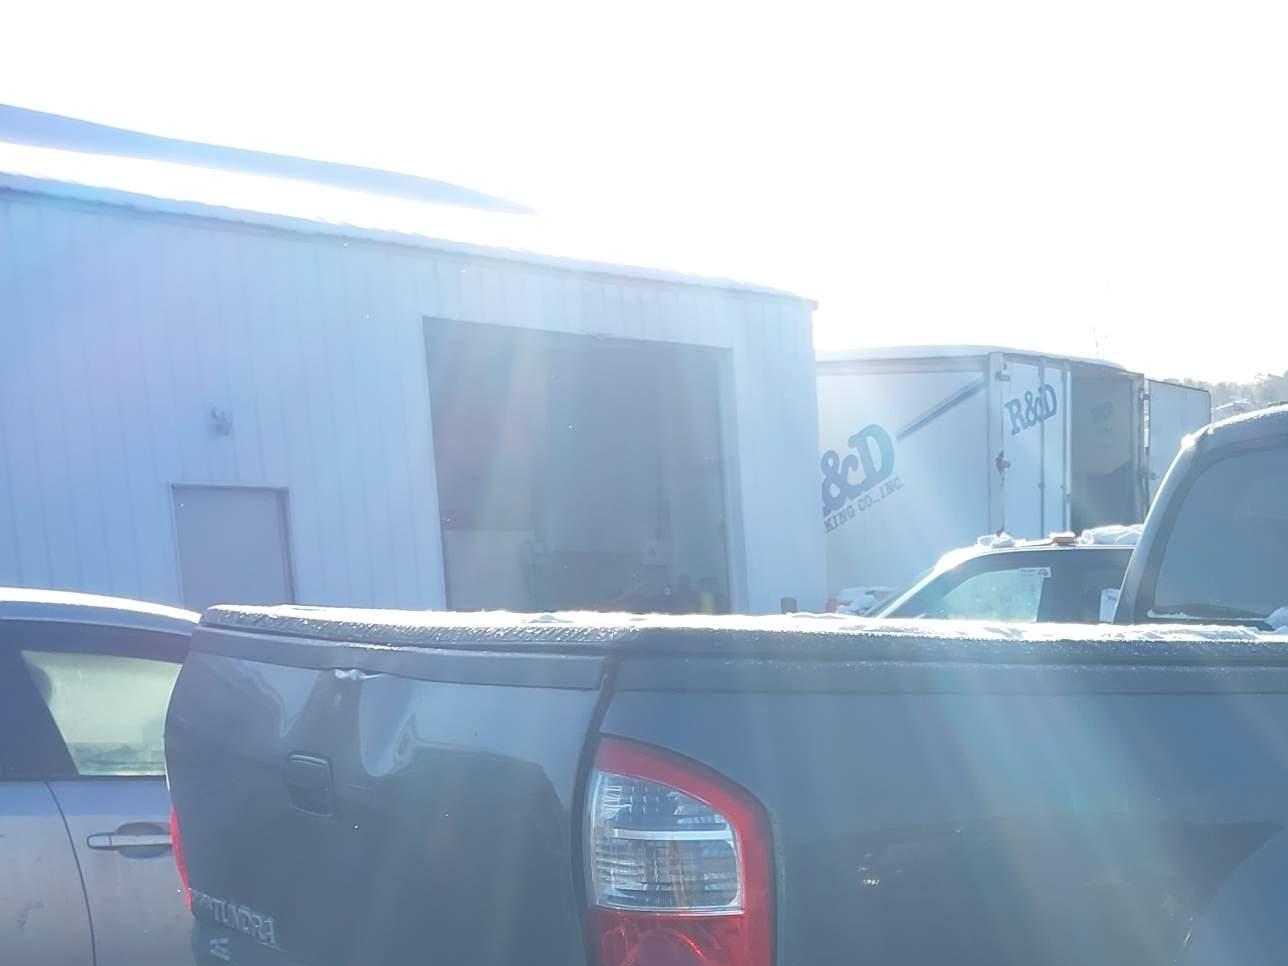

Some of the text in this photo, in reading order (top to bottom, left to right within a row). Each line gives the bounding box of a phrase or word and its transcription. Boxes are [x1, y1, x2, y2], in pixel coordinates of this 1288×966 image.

[1004, 384, 1057, 436] R&D
[822, 424, 895, 518] &D
[209, 897, 275, 945] TUNDRA
